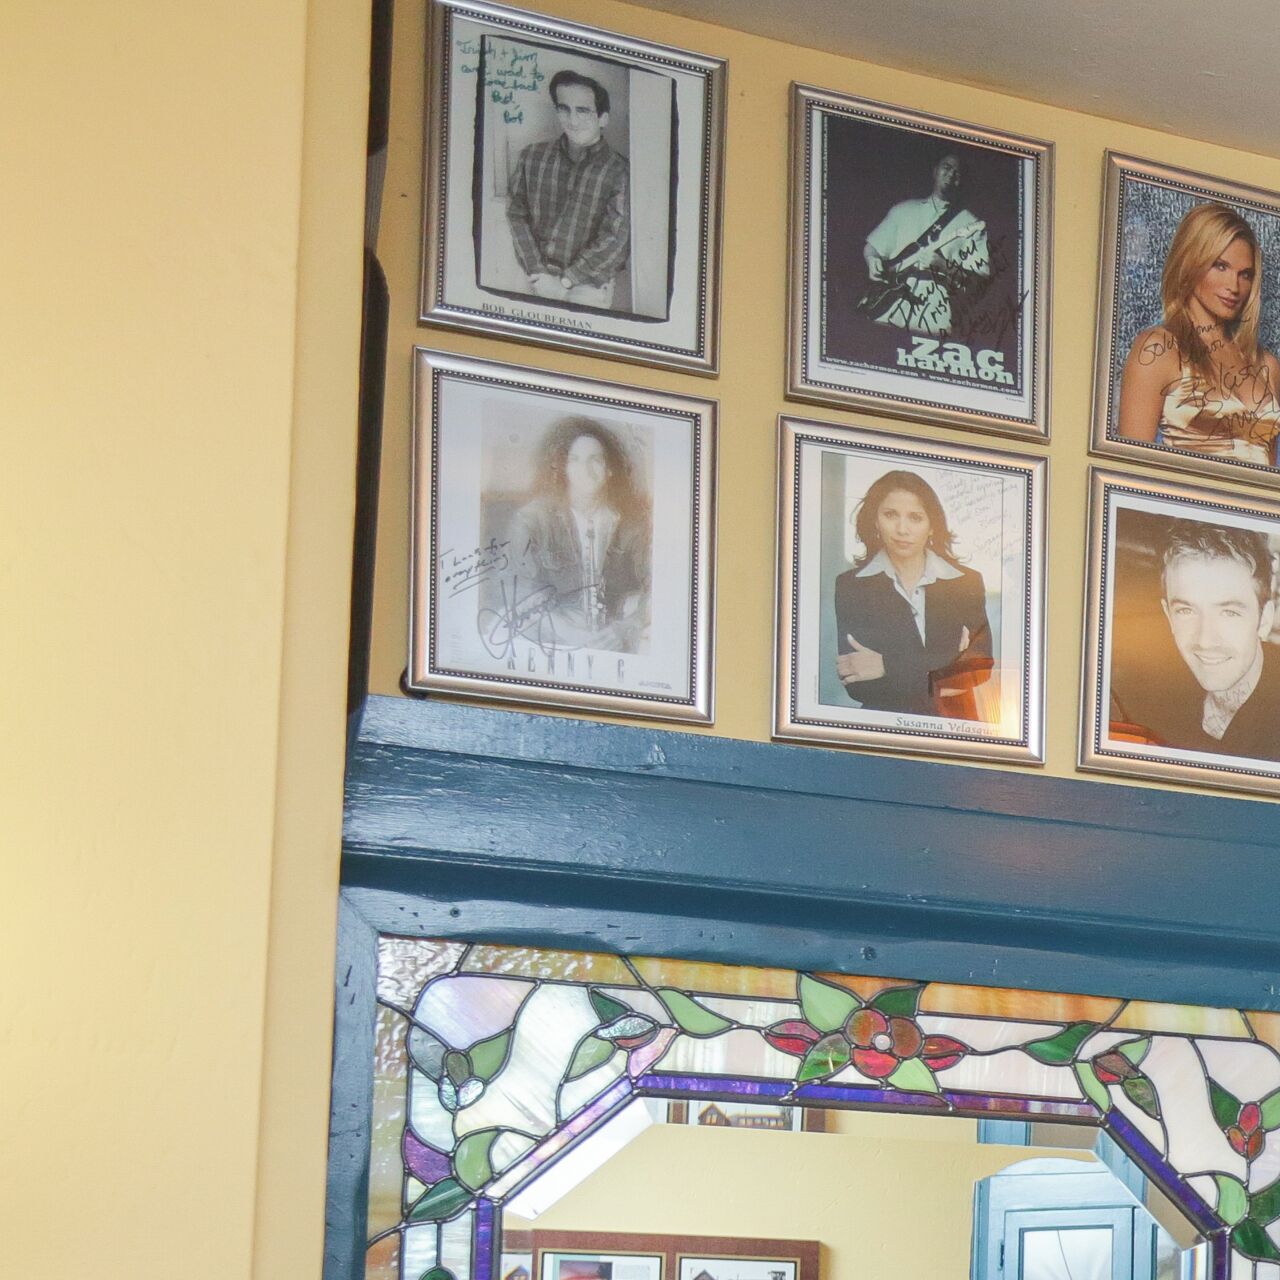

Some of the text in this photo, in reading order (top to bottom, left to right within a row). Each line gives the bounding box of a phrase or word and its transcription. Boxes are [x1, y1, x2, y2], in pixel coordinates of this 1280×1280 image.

[482, 302, 593, 330] BOB GLOUBERMAN
[897, 348, 1014, 385] harmon
[911, 336, 1004, 371] zac
[826, 356, 1018, 394] www.zacharmon.com www.zacharmon.com
[507, 648, 595, 681] KENNY
[896, 716, 943, 731] Susanna
